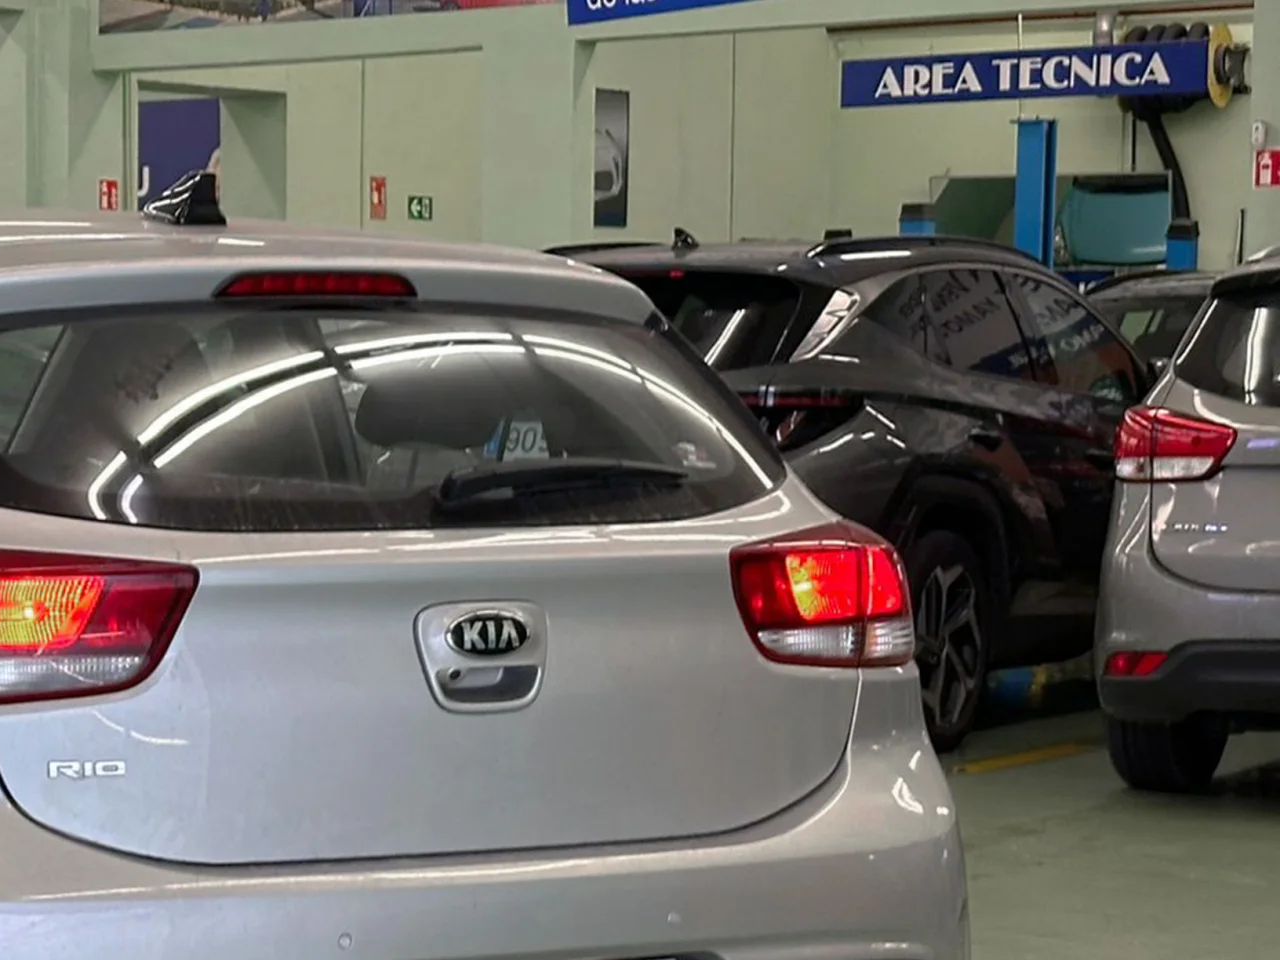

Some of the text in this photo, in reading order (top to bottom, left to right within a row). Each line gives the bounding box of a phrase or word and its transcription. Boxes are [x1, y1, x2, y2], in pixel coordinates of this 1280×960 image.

[875, 51, 1170, 98] AREA TECNICA
[461, 619, 520, 650] KIA
[47, 760, 126, 779] RIO
